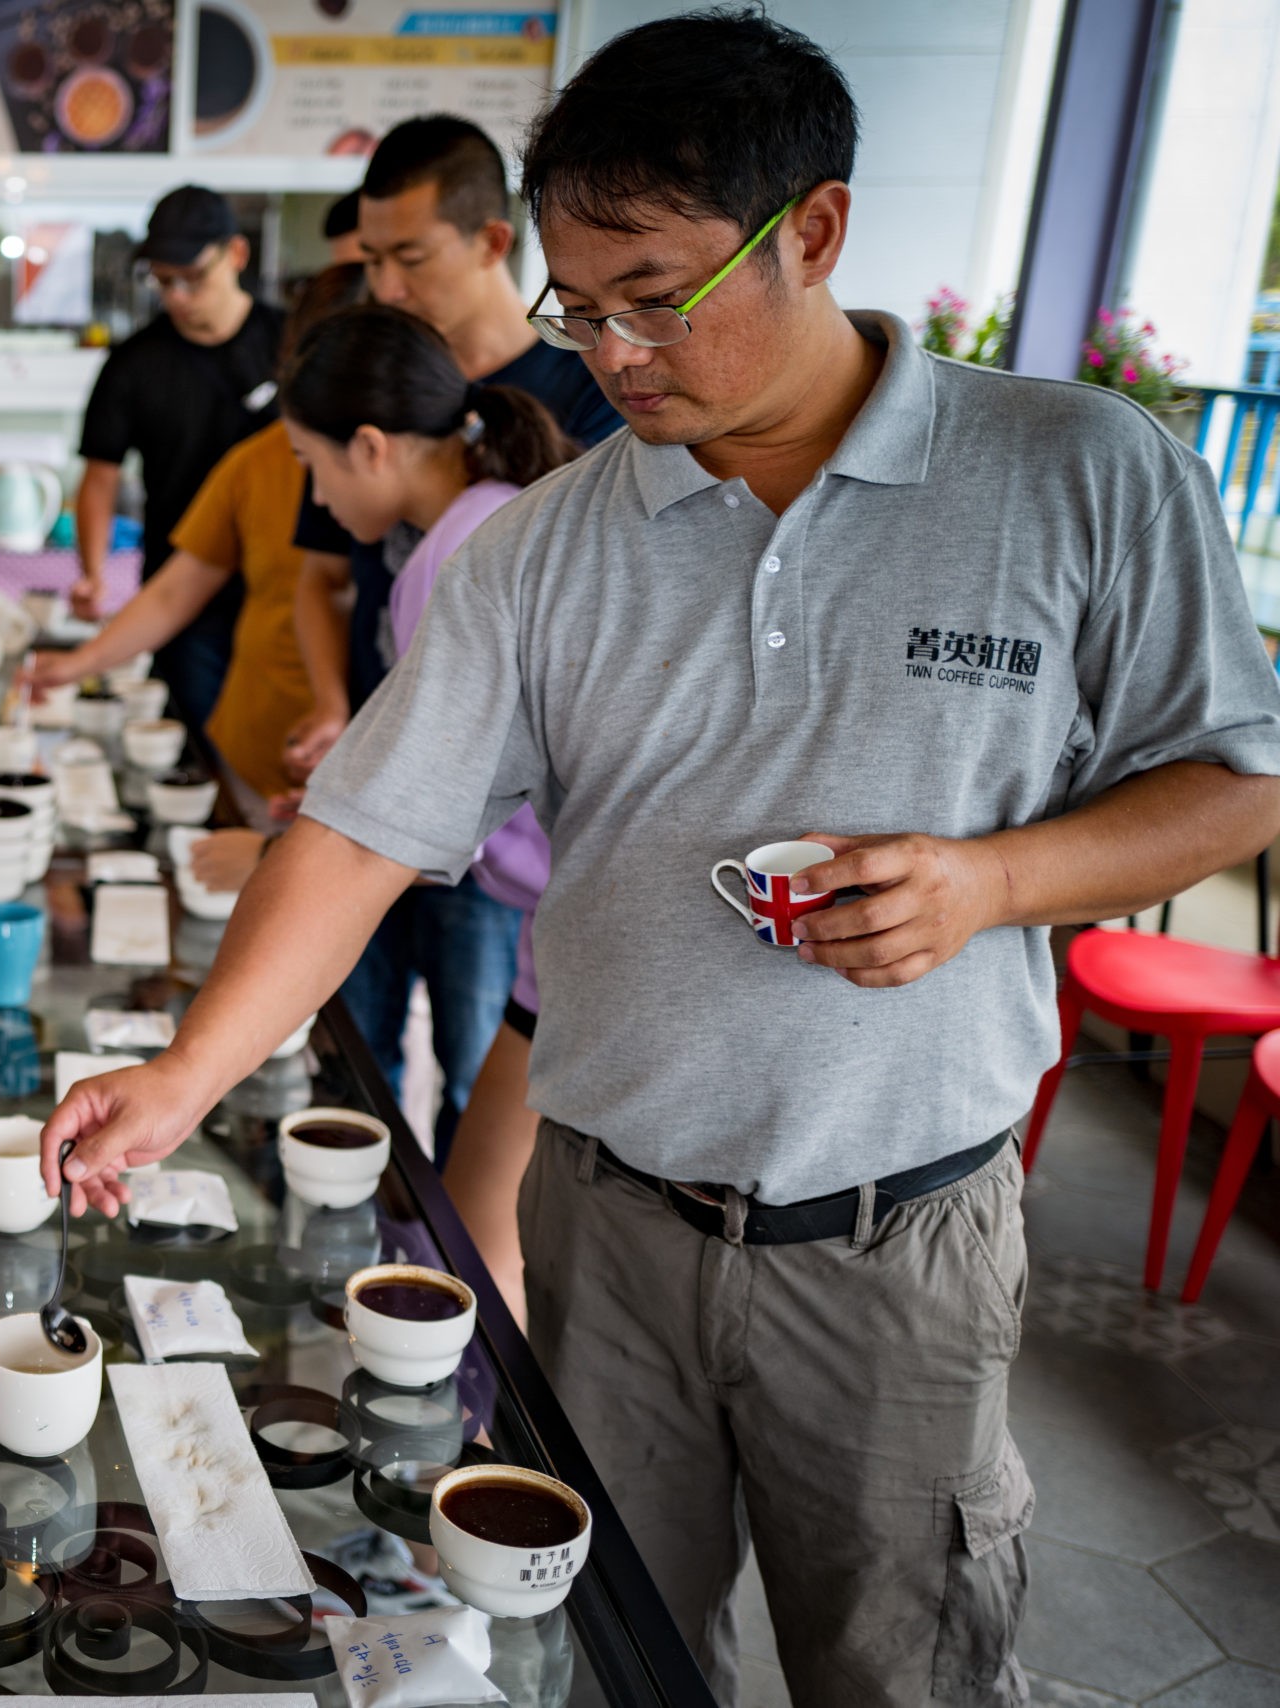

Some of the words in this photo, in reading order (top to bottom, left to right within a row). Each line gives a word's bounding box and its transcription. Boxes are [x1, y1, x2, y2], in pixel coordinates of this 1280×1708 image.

[906, 627, 1042, 676] 菁英莊園
[905, 664, 932, 679] TWN
[937, 667, 985, 686] COFFEE
[989, 675, 1035, 695] CUPPING
